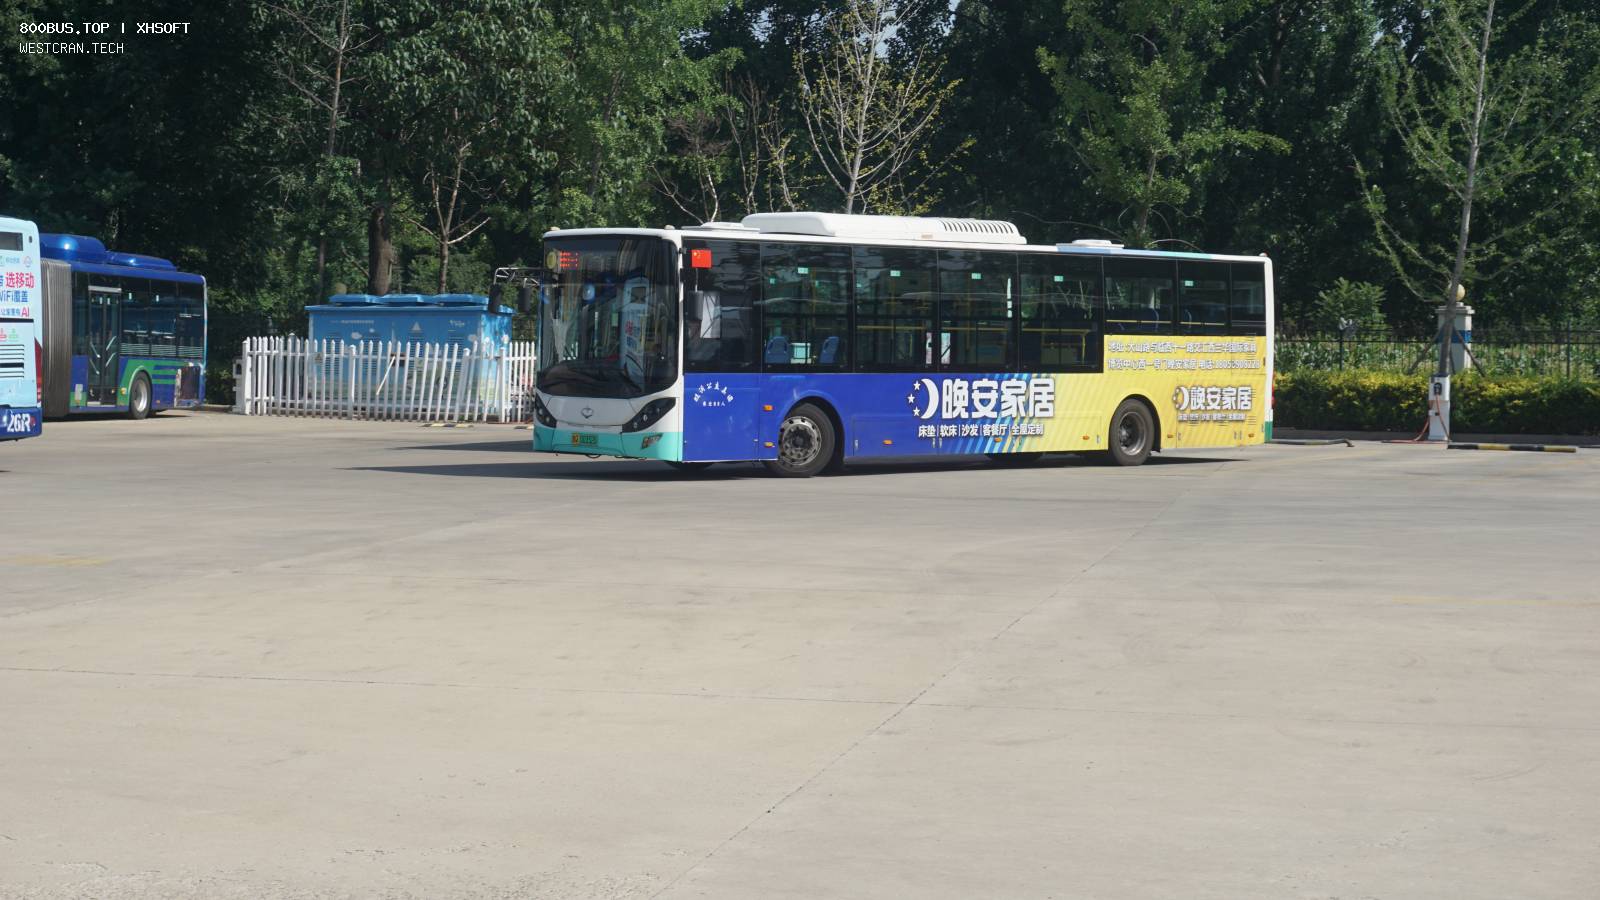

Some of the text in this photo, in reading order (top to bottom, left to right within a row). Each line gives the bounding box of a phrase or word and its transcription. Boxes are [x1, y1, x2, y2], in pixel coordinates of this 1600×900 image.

[5, 271, 35, 289] 选移动
[942, 378, 1056, 419] 晚安家居
[1190, 386, 1252, 410] 晚安家居
